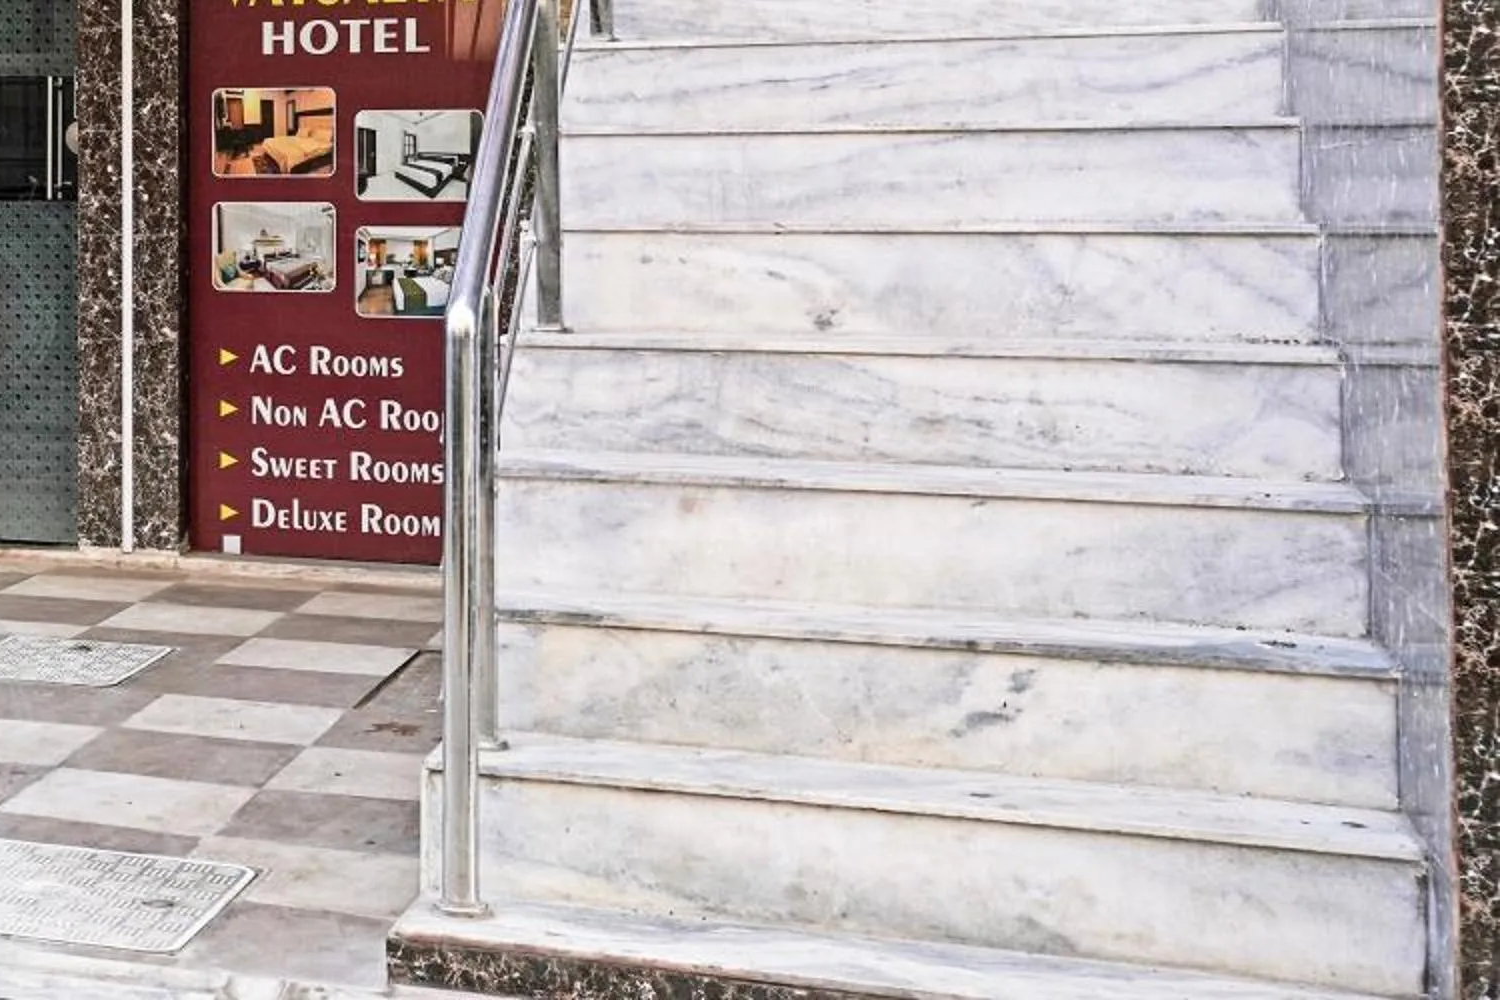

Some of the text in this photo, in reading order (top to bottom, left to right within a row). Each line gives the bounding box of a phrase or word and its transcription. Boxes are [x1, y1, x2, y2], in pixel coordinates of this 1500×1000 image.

[261, 17, 431, 55] HOTEL
[250, 344, 297, 375] AC
[318, 398, 366, 429] AC
[380, 400, 445, 432] ROO
[361, 503, 441, 537] ROOM
